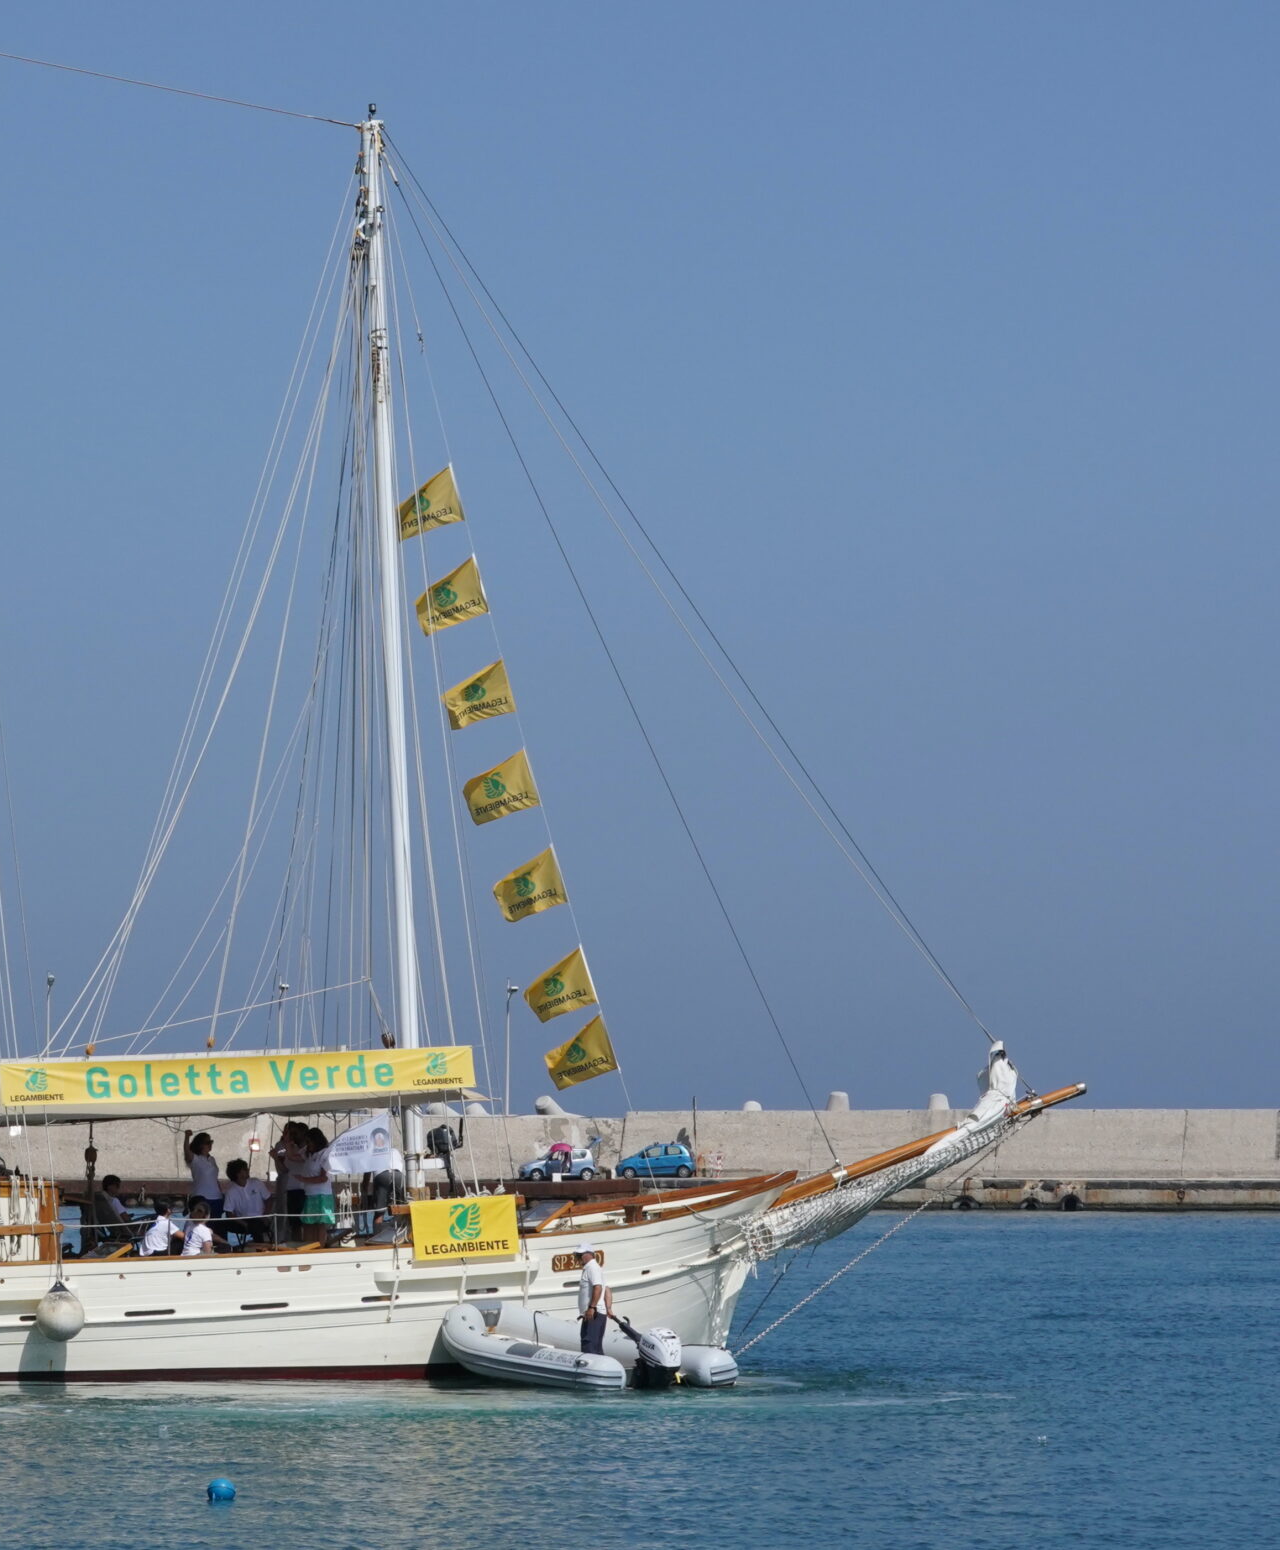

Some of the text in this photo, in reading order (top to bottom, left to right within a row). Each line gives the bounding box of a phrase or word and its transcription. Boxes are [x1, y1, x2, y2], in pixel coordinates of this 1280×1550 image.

[86, 1055, 395, 1098] Goletta Verde
[413, 1077, 463, 1086] LEGAMBIENTE
[10, 1094, 64, 1102] LEGAMBIENTE
[425, 1240, 509, 1255] LEGAMBIENTE
[554, 1255, 567, 1270] SP
